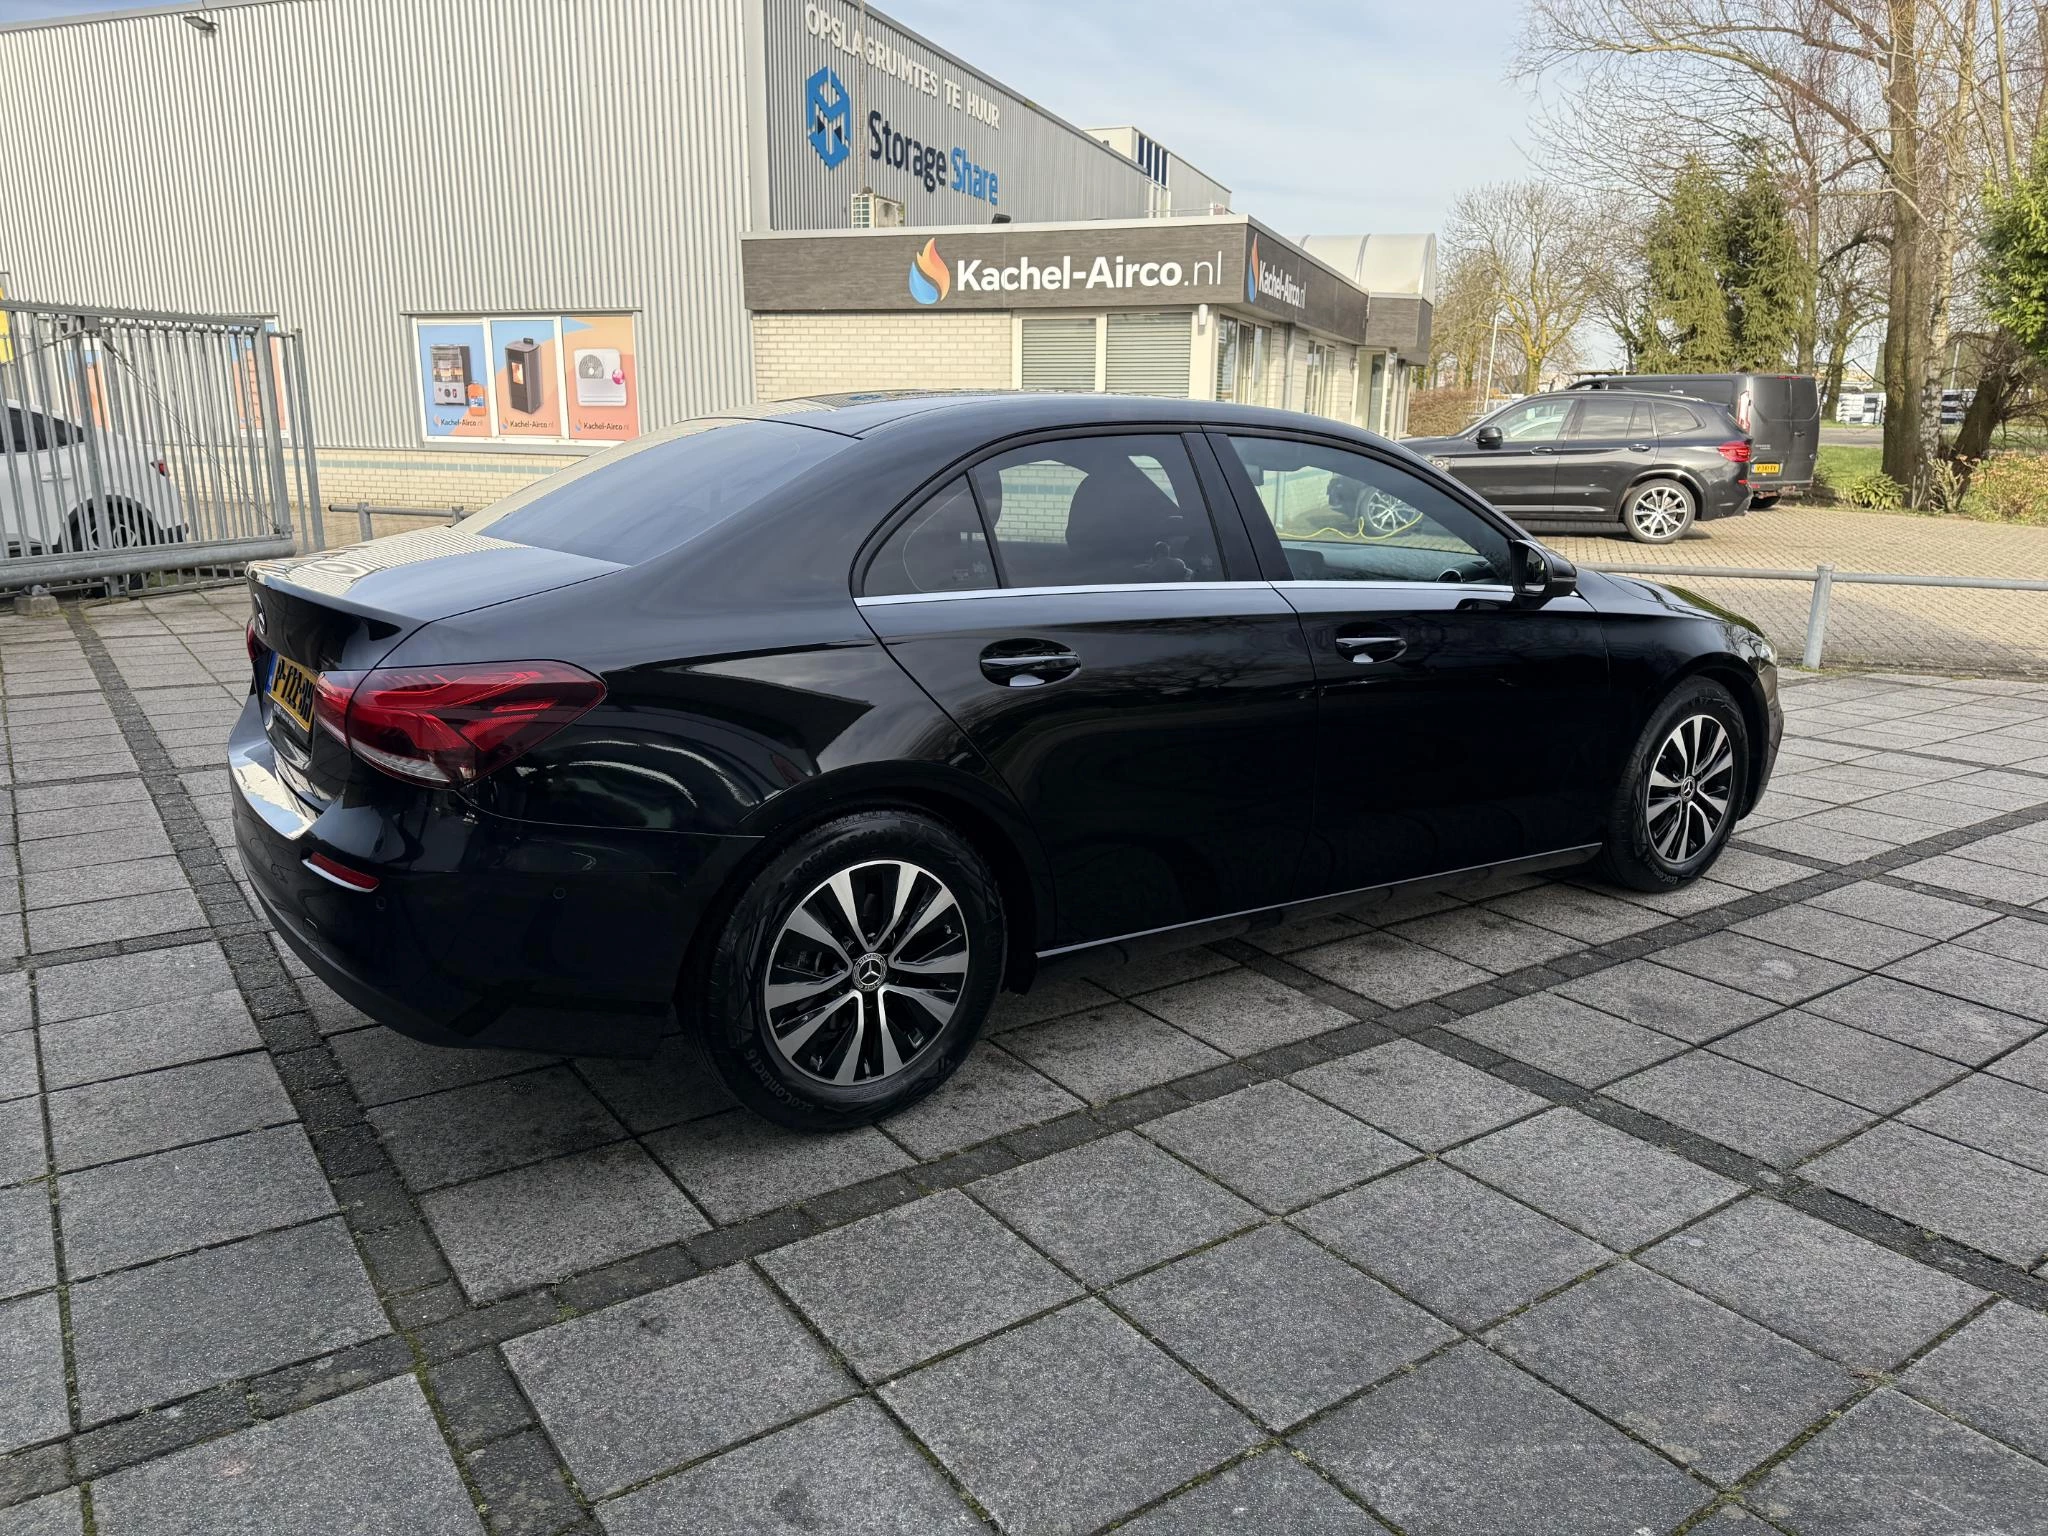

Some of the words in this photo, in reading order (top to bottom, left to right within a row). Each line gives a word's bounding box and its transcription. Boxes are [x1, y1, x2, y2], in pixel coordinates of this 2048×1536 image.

[805, 3, 938, 99] OPSLAGRUIMTES
[944, 78, 962, 111] TE
[967, 90, 1000, 130] HUUR
[869, 110, 947, 193] Storage
[951, 147, 998, 206] Share
[957, 250, 1222, 292] Kachel-Airco.nl
[1258, 260, 1307, 309] Kachel-Airco.nl
